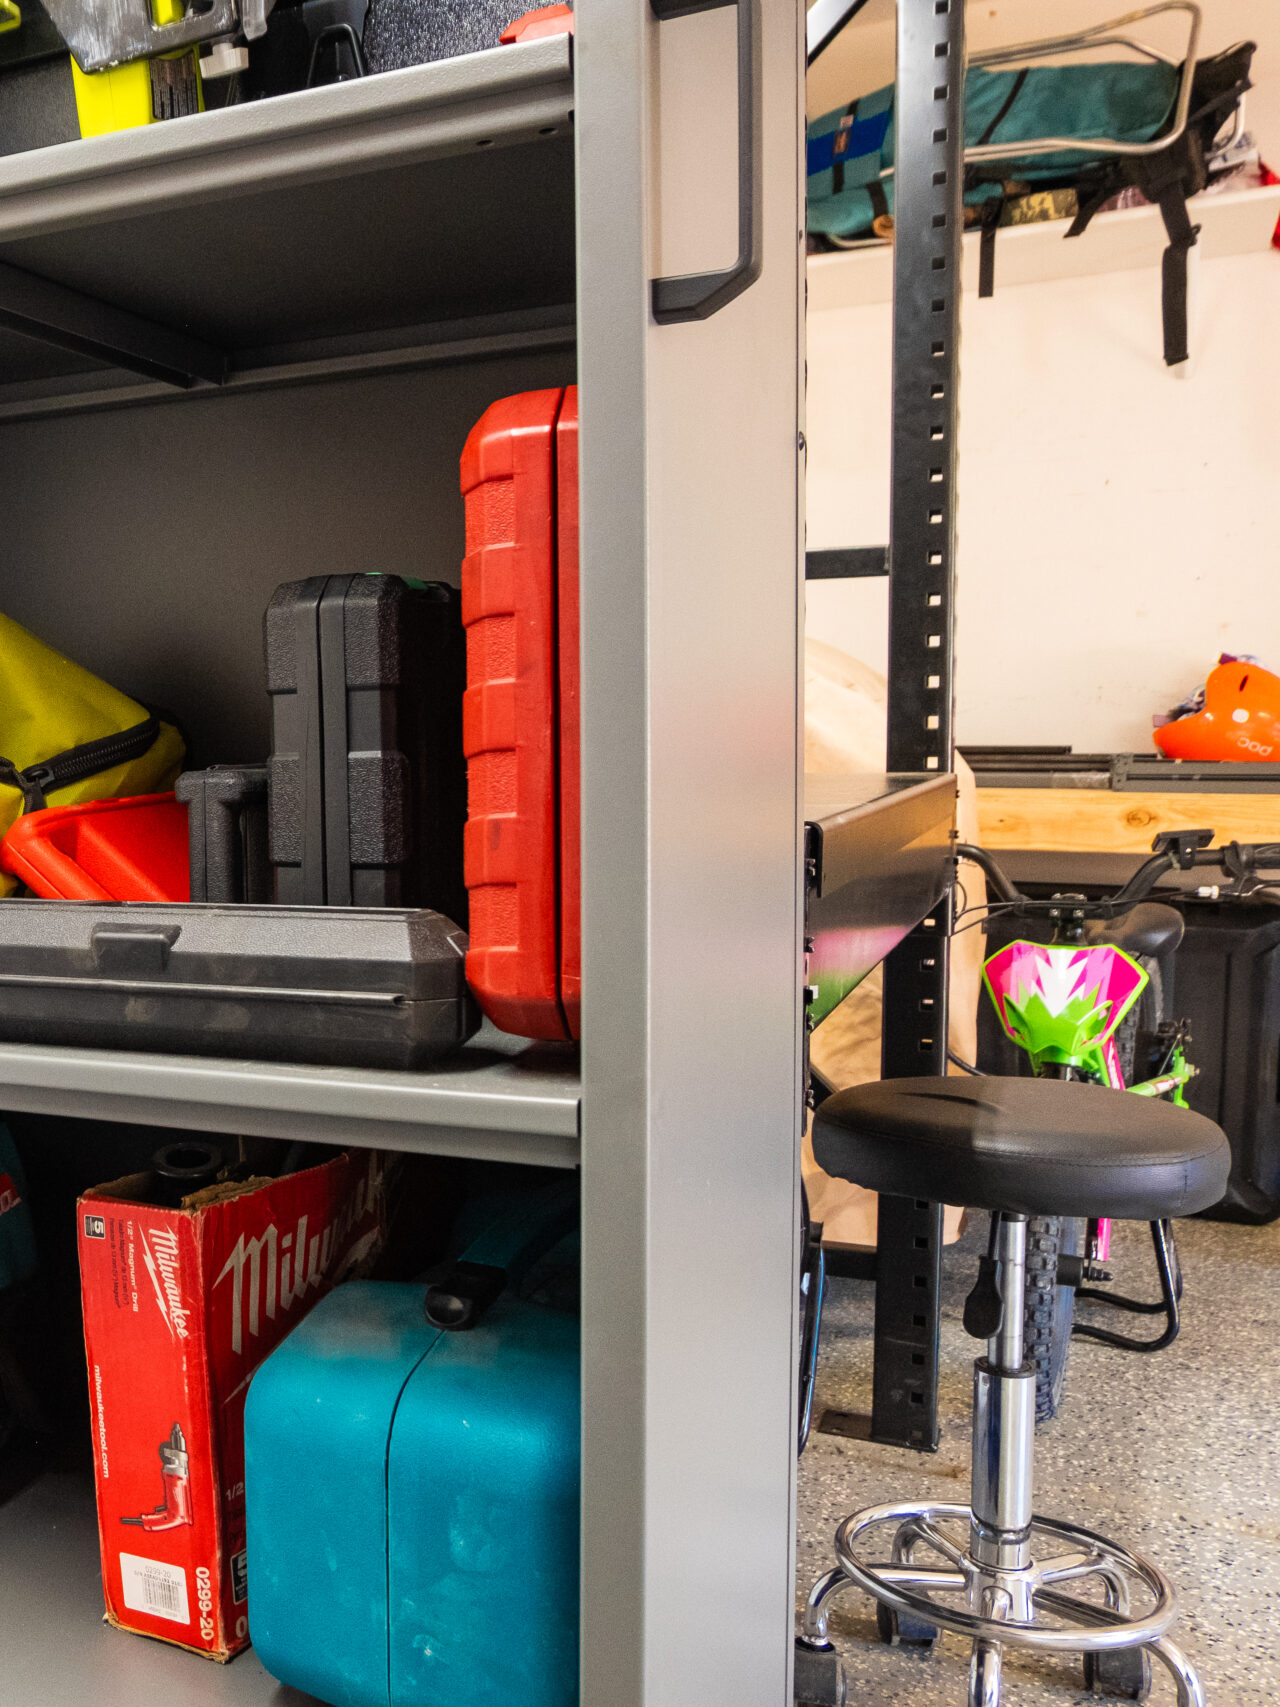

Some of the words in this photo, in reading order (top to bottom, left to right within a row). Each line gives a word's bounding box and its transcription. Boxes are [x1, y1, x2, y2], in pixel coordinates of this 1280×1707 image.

[1237, 736, 1273, 757] poc
[94, 1220, 104, 1234] 5
[131, 1291, 139, 1313] Drill
[148, 1224, 191, 1340] Milwaukee
[94, 1364, 109, 1479] milwaukeetool.com
[195, 1566, 215, 1641] 0299-20
